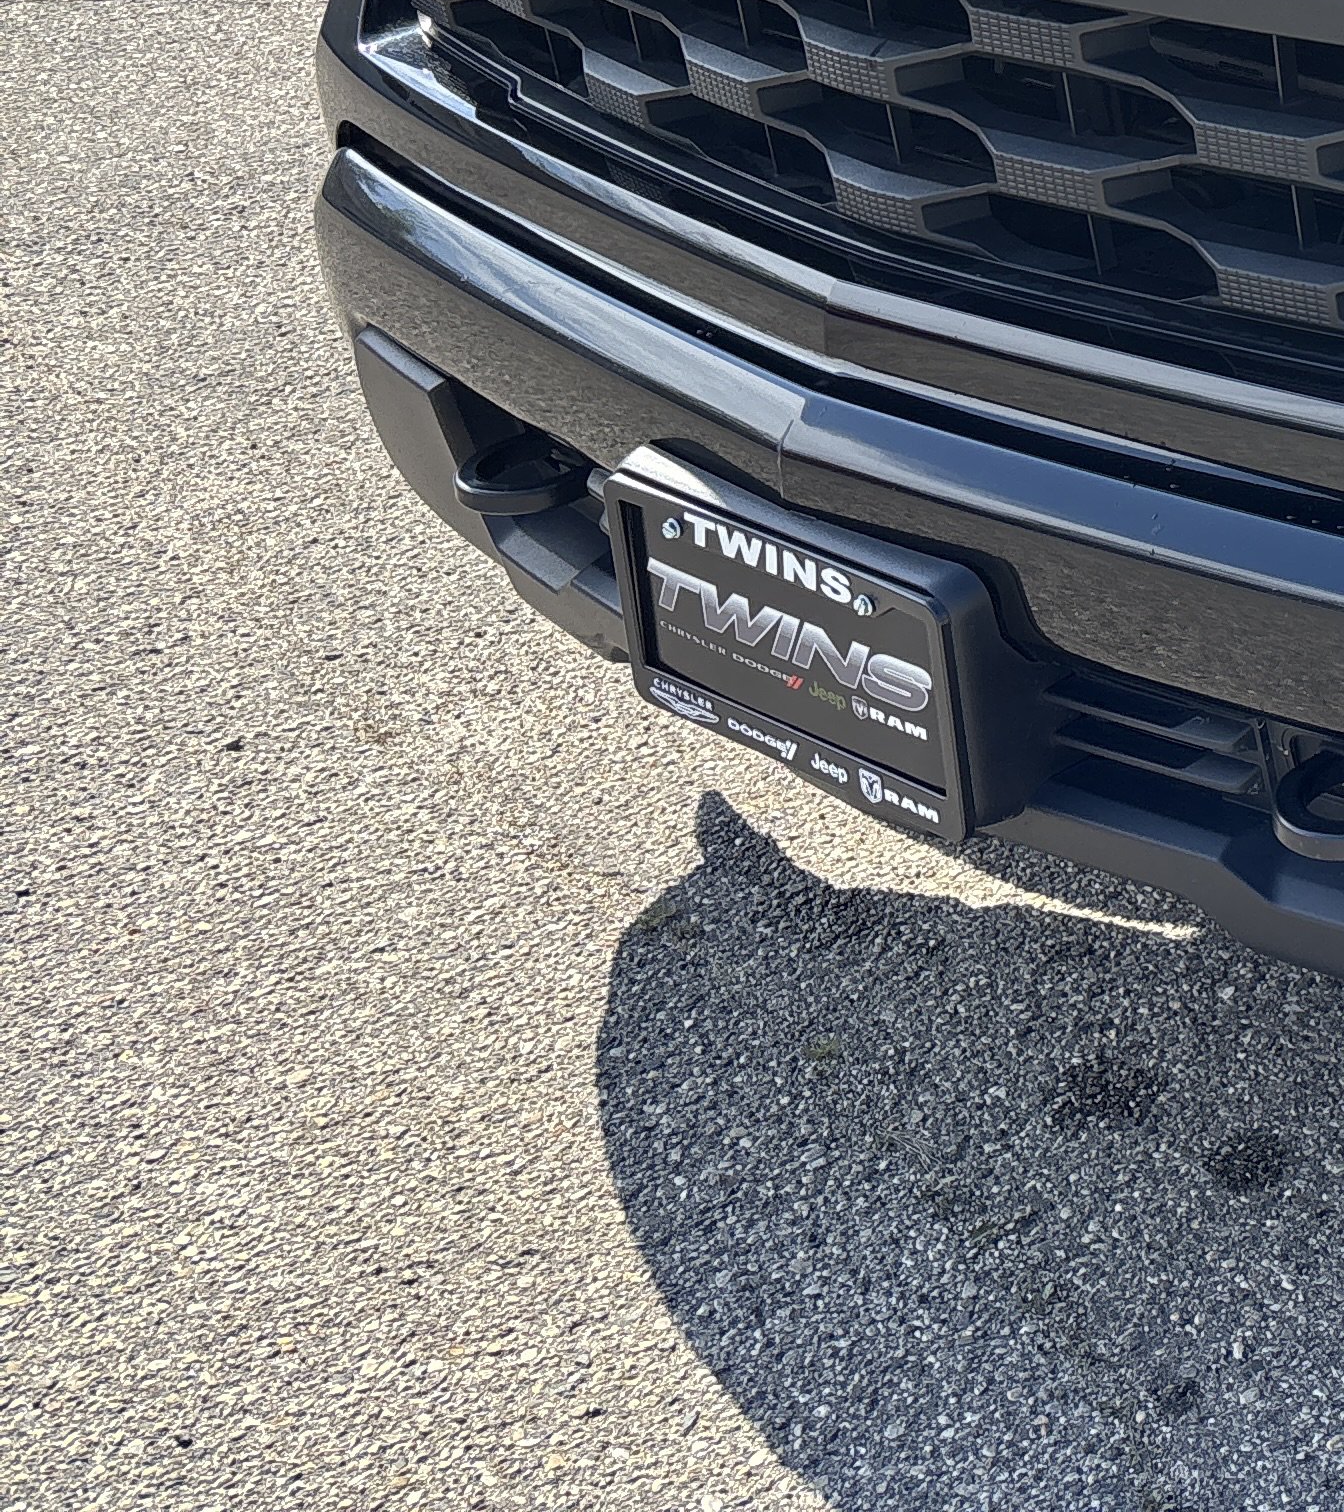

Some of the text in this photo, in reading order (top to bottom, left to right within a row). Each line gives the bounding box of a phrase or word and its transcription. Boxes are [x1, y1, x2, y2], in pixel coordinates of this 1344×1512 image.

[684, 512, 852, 604] TWINS
[647, 556, 932, 712] TWINS
[659, 619, 928, 741] CHRYSLER DODGE Jeep RAM
[653, 677, 939, 824] CHRYSLER DODGE Jeep RAM
